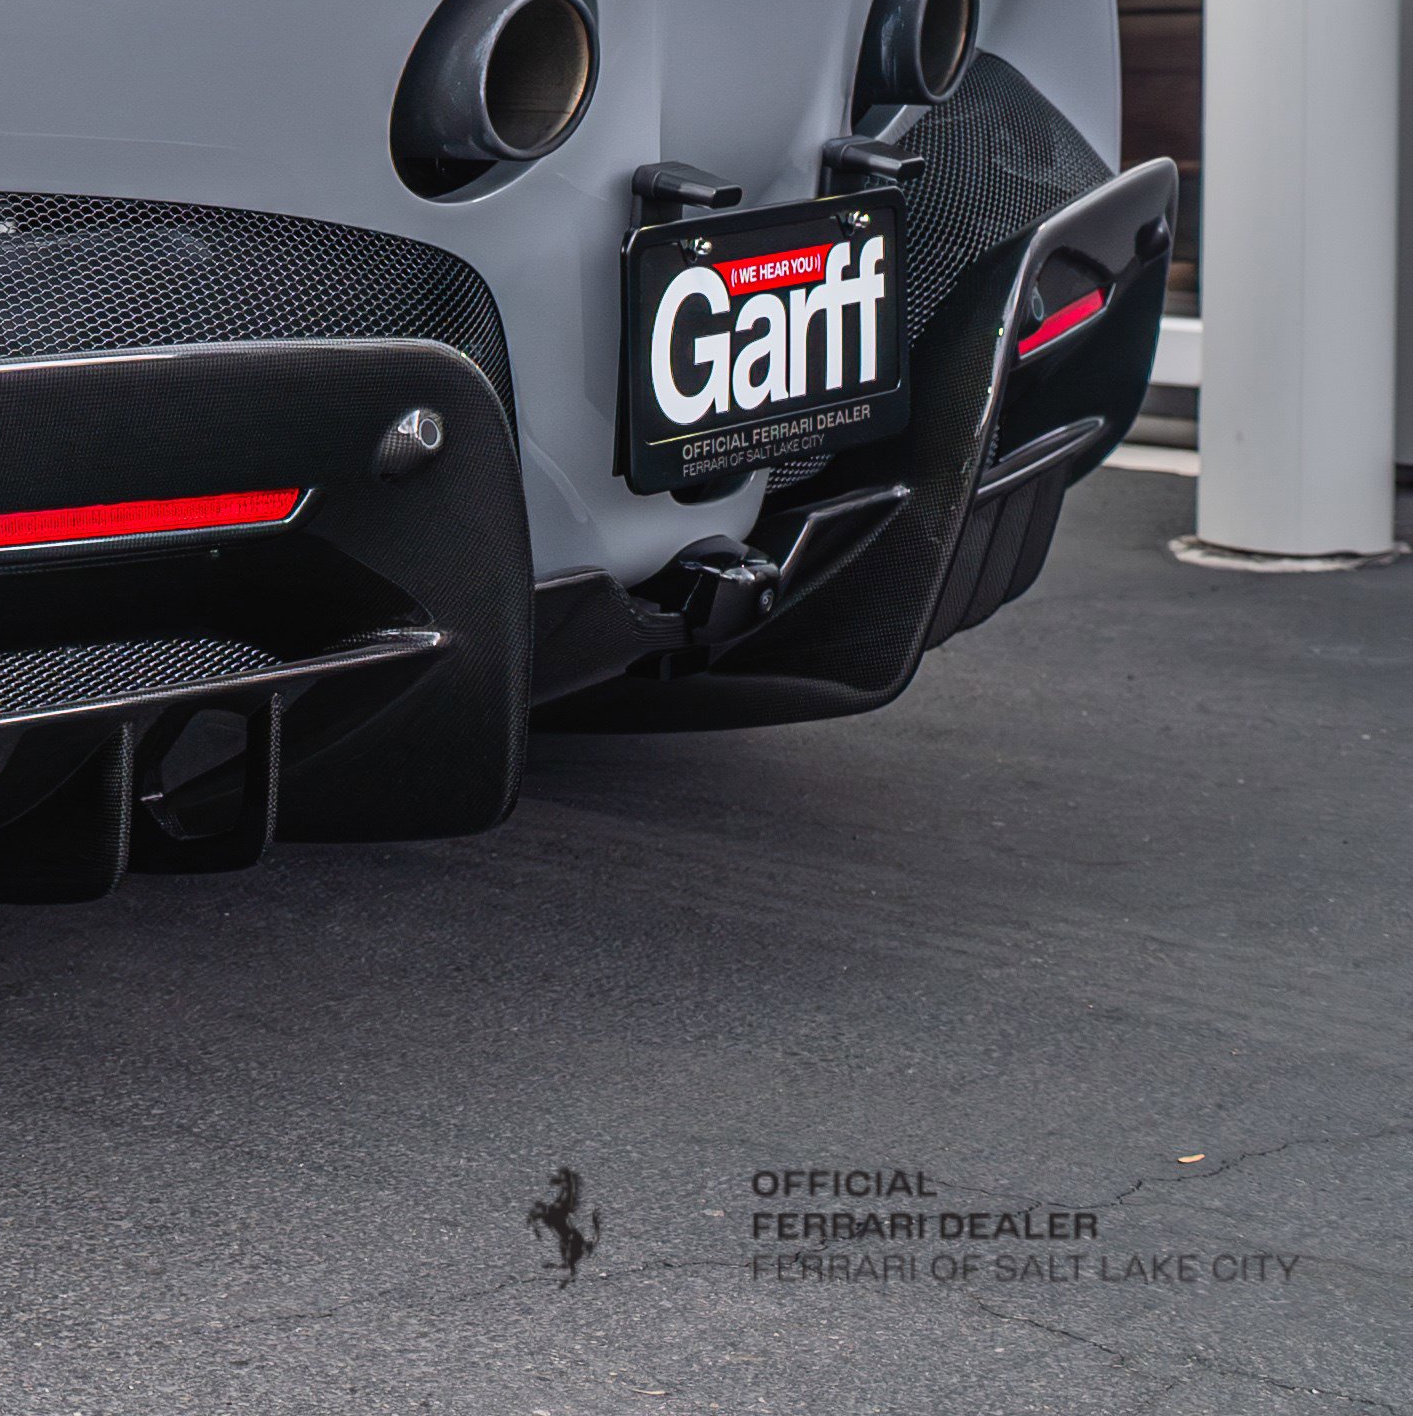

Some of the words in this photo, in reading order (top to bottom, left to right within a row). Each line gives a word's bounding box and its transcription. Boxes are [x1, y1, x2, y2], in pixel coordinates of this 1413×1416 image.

[739, 266, 758, 284] WE
[759, 259, 790, 281] HEAR
[790, 256, 814, 274] YOU
[651, 235, 884, 425] Garff
[682, 432, 750, 460] OFFICIAL
[752, 417, 813, 445] FERRARI
[816, 404, 871, 429] DEALER
[683, 456, 729, 477] FERRARI
[729, 451, 745, 467] OF
[746, 445, 772, 463] SALT
[773, 438, 801, 456] LAKE
[801, 433, 825, 450] CITY
